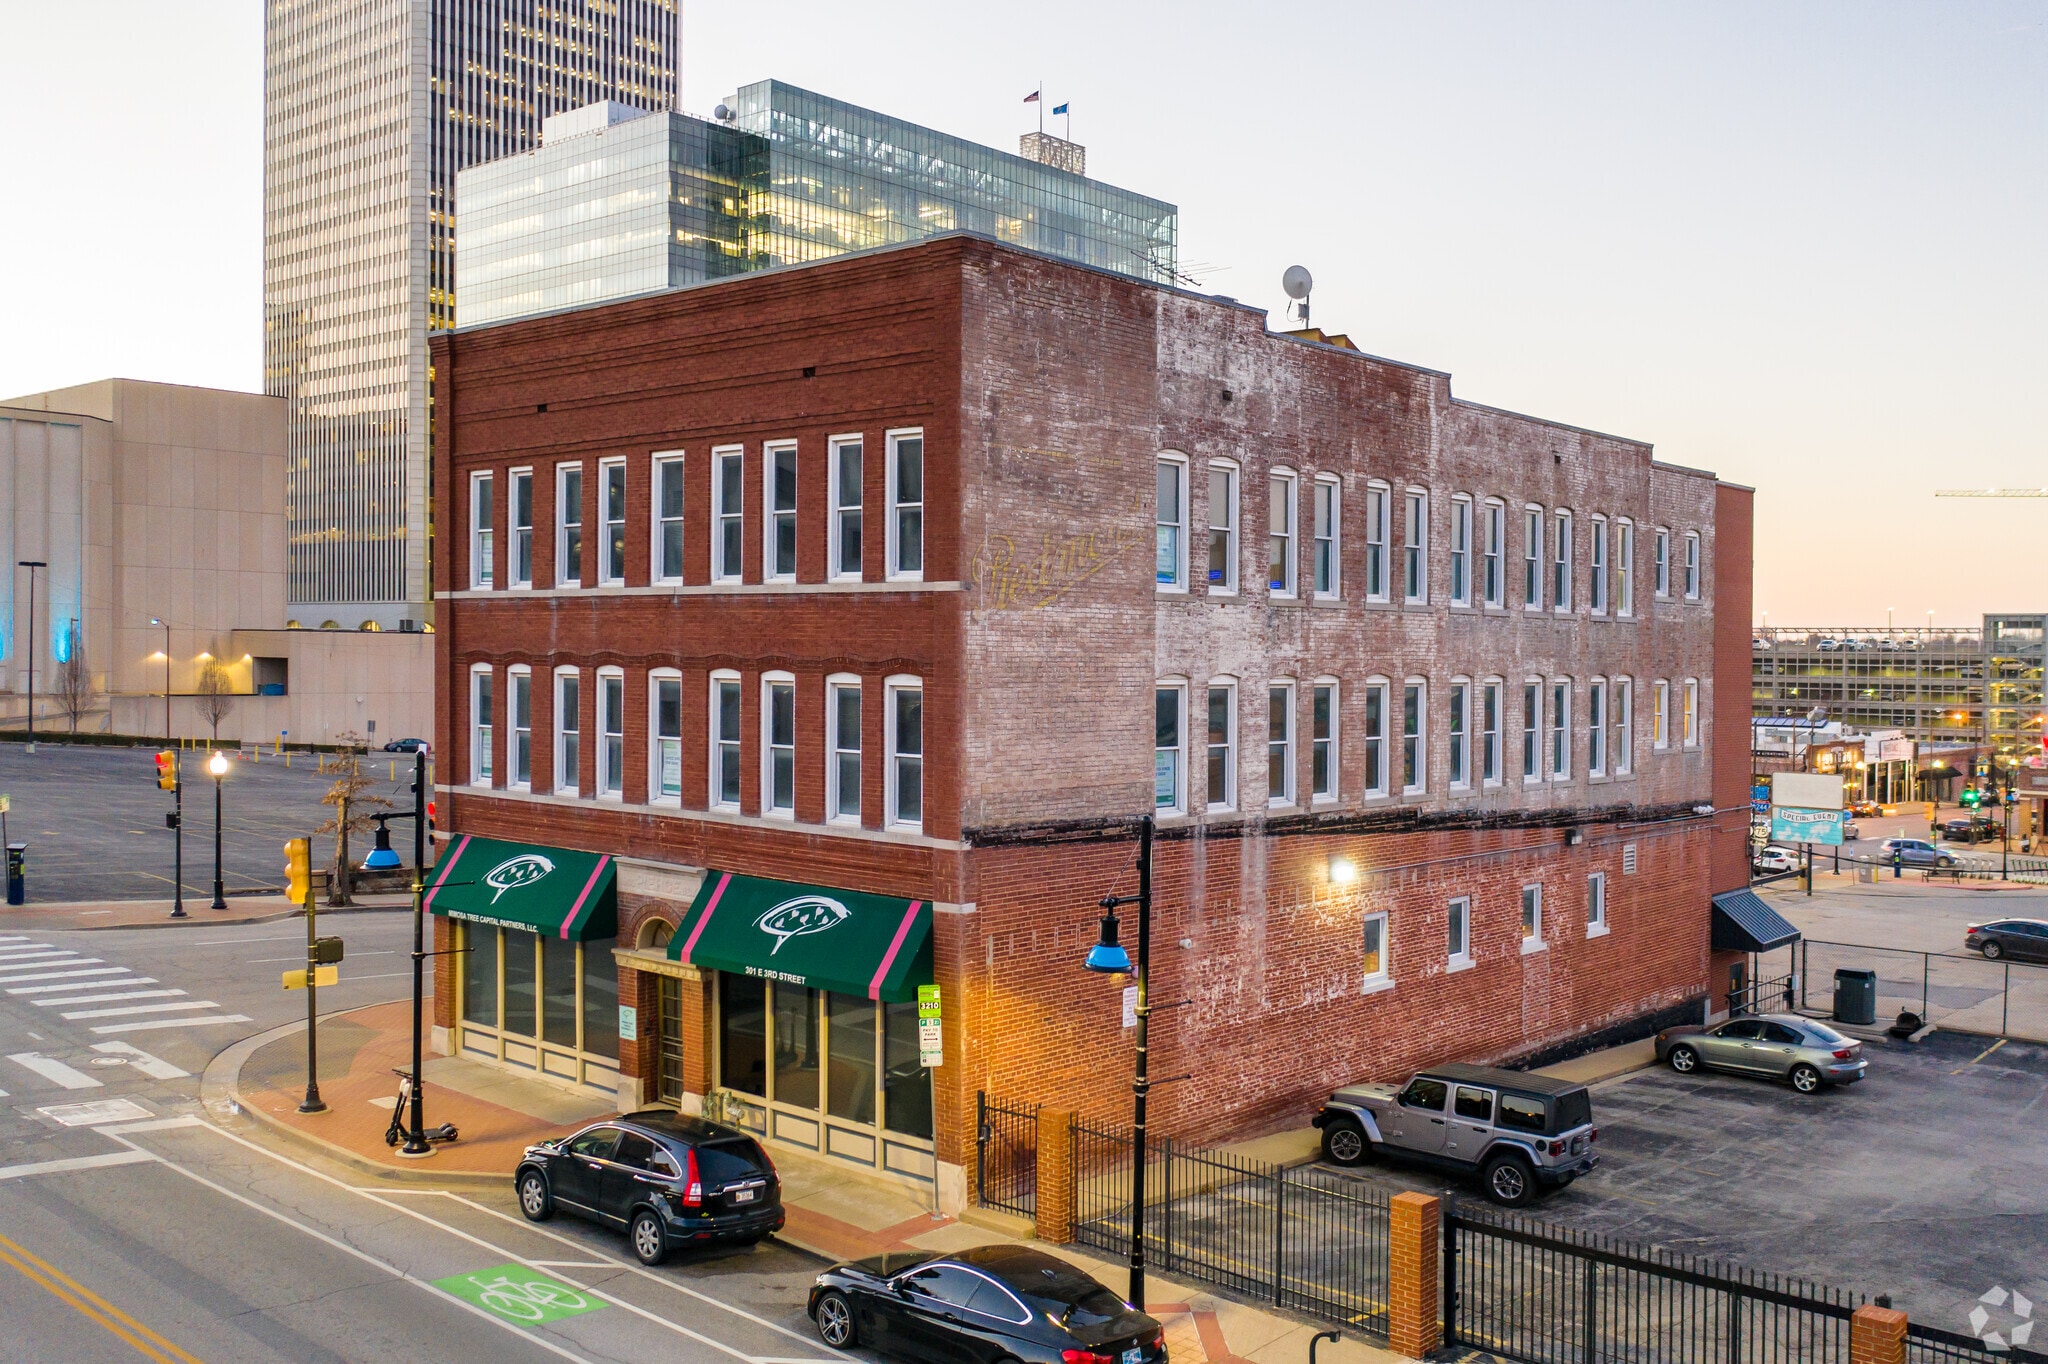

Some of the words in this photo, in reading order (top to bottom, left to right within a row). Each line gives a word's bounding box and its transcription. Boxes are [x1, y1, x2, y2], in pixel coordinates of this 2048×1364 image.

[1783, 812, 1810, 821] SPECIAL
[448, 909, 466, 920] MIMOSA
[467, 913, 479, 922] TREE
[480, 915, 499, 926] CAPITAL
[500, 919, 526, 931] PARTNERS,
[526, 924, 538, 932] LLC.
[745, 966, 756, 975] 301
[758, 968, 763, 976] E
[764, 969, 777, 979] 3RD
[779, 972, 806, 984] STREET
